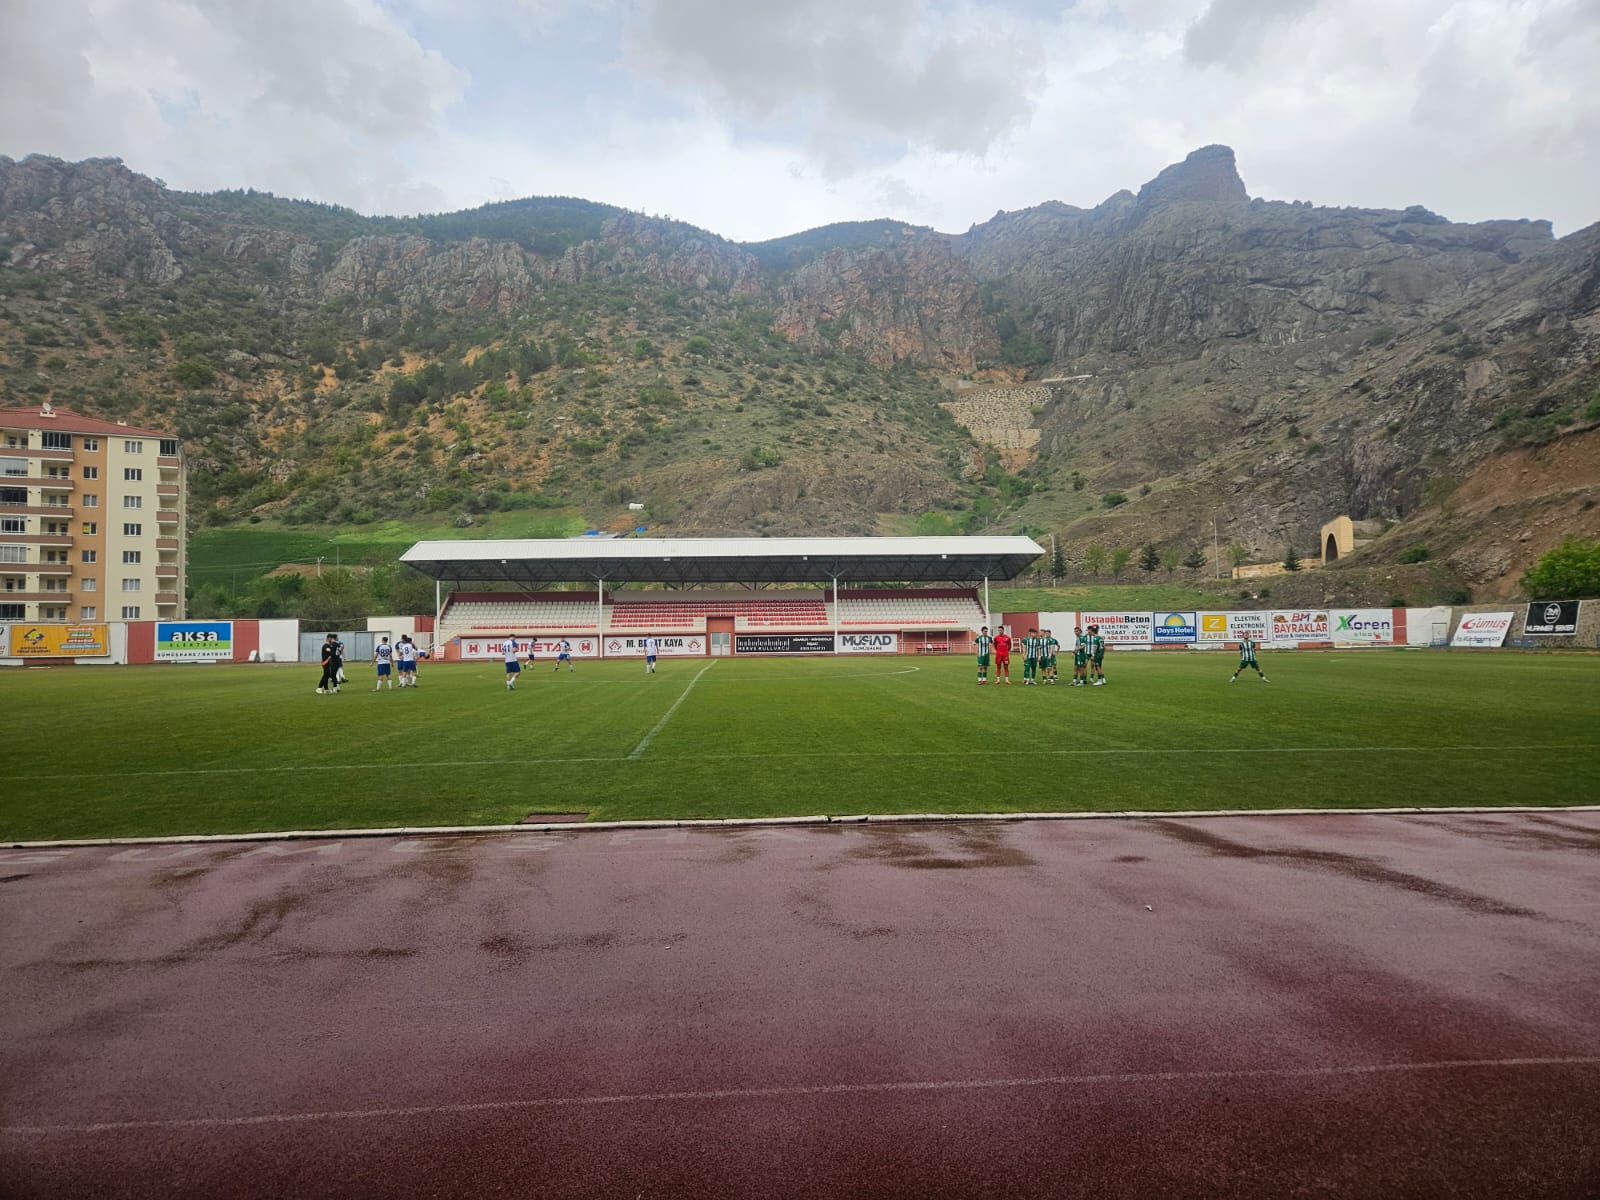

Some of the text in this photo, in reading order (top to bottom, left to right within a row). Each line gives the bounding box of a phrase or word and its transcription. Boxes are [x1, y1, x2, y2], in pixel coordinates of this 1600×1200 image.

[1291, 613, 1311, 622] BM
[1274, 623, 1328, 633] BAYRAKLAR
[172, 631, 218, 642] aksa
[842, 635, 892, 646] MÜSİAD
[626, 639, 636, 648] M.
[664, 639, 683, 648] KAYA
